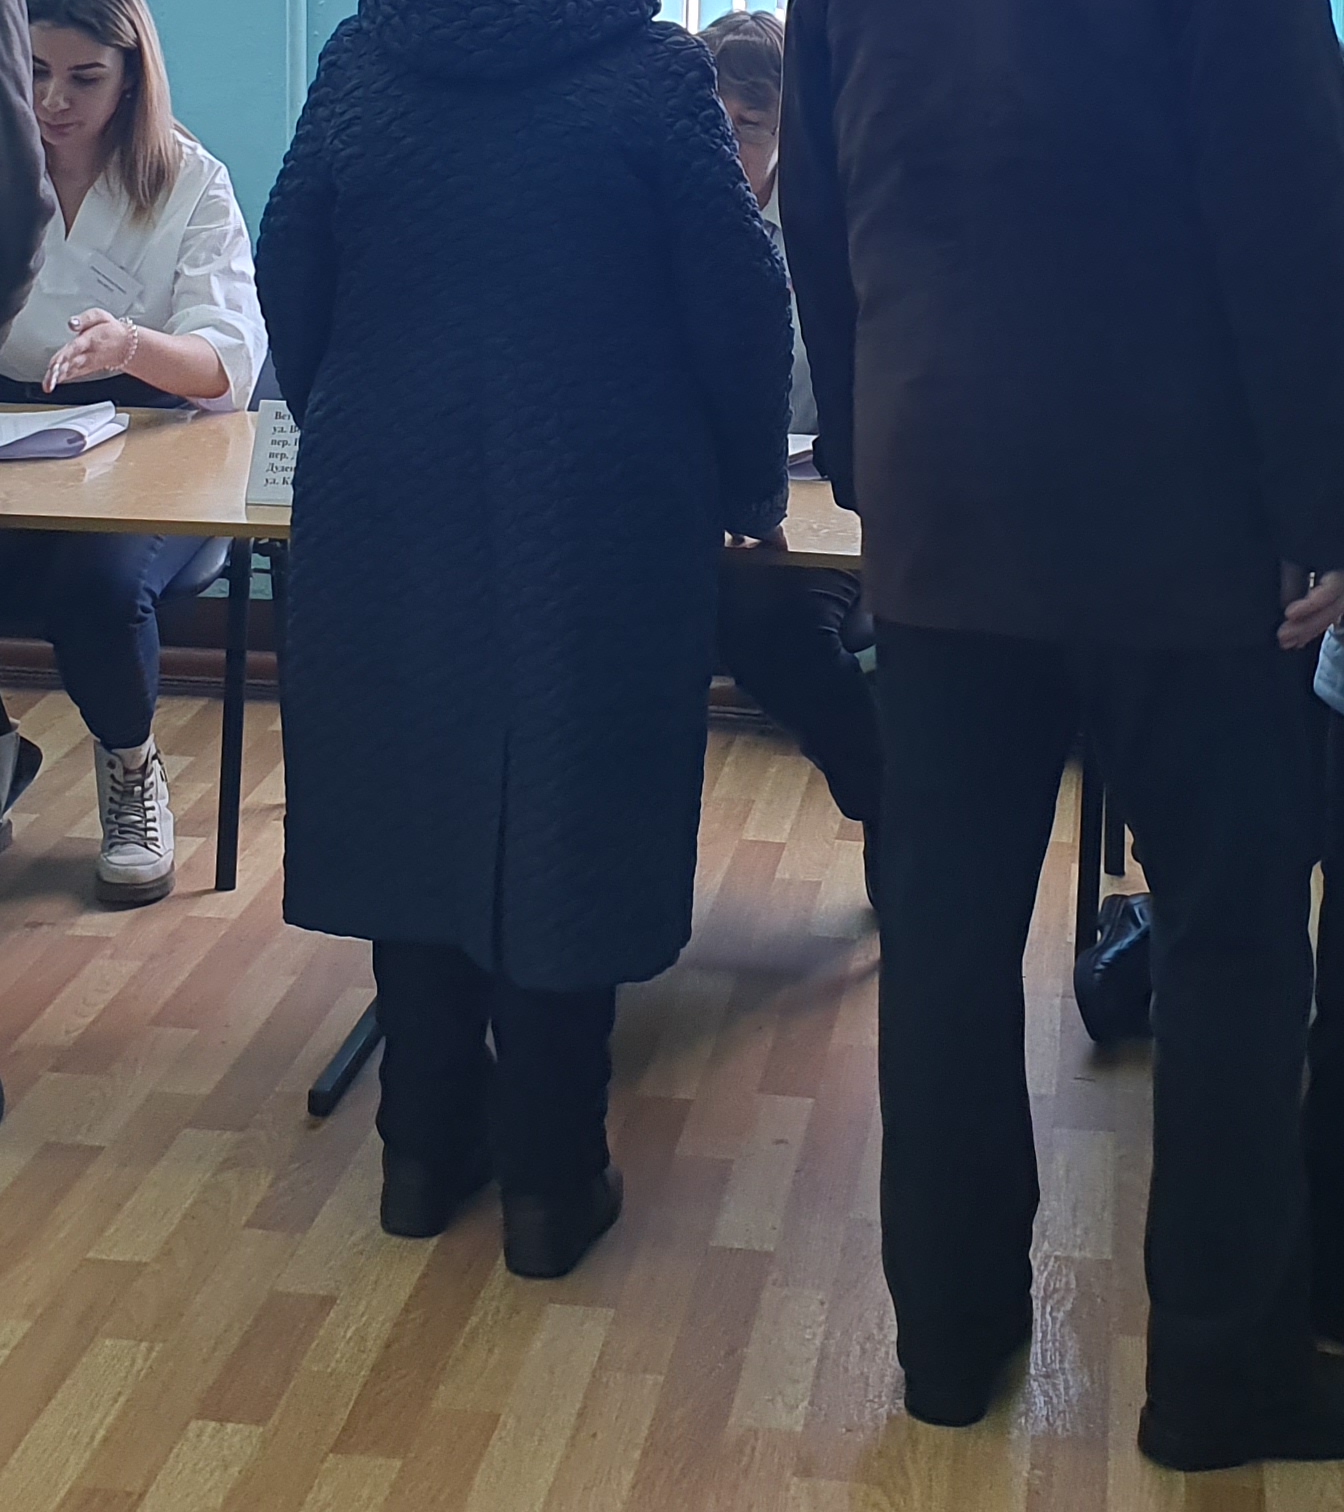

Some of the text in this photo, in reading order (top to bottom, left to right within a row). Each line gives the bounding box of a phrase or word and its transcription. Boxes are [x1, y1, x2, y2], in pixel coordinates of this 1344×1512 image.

[272, 427, 287, 435] ул.
[271, 439, 291, 448] пер.
[268, 452, 288, 461] пер.
[264, 477, 279, 487] ул.
